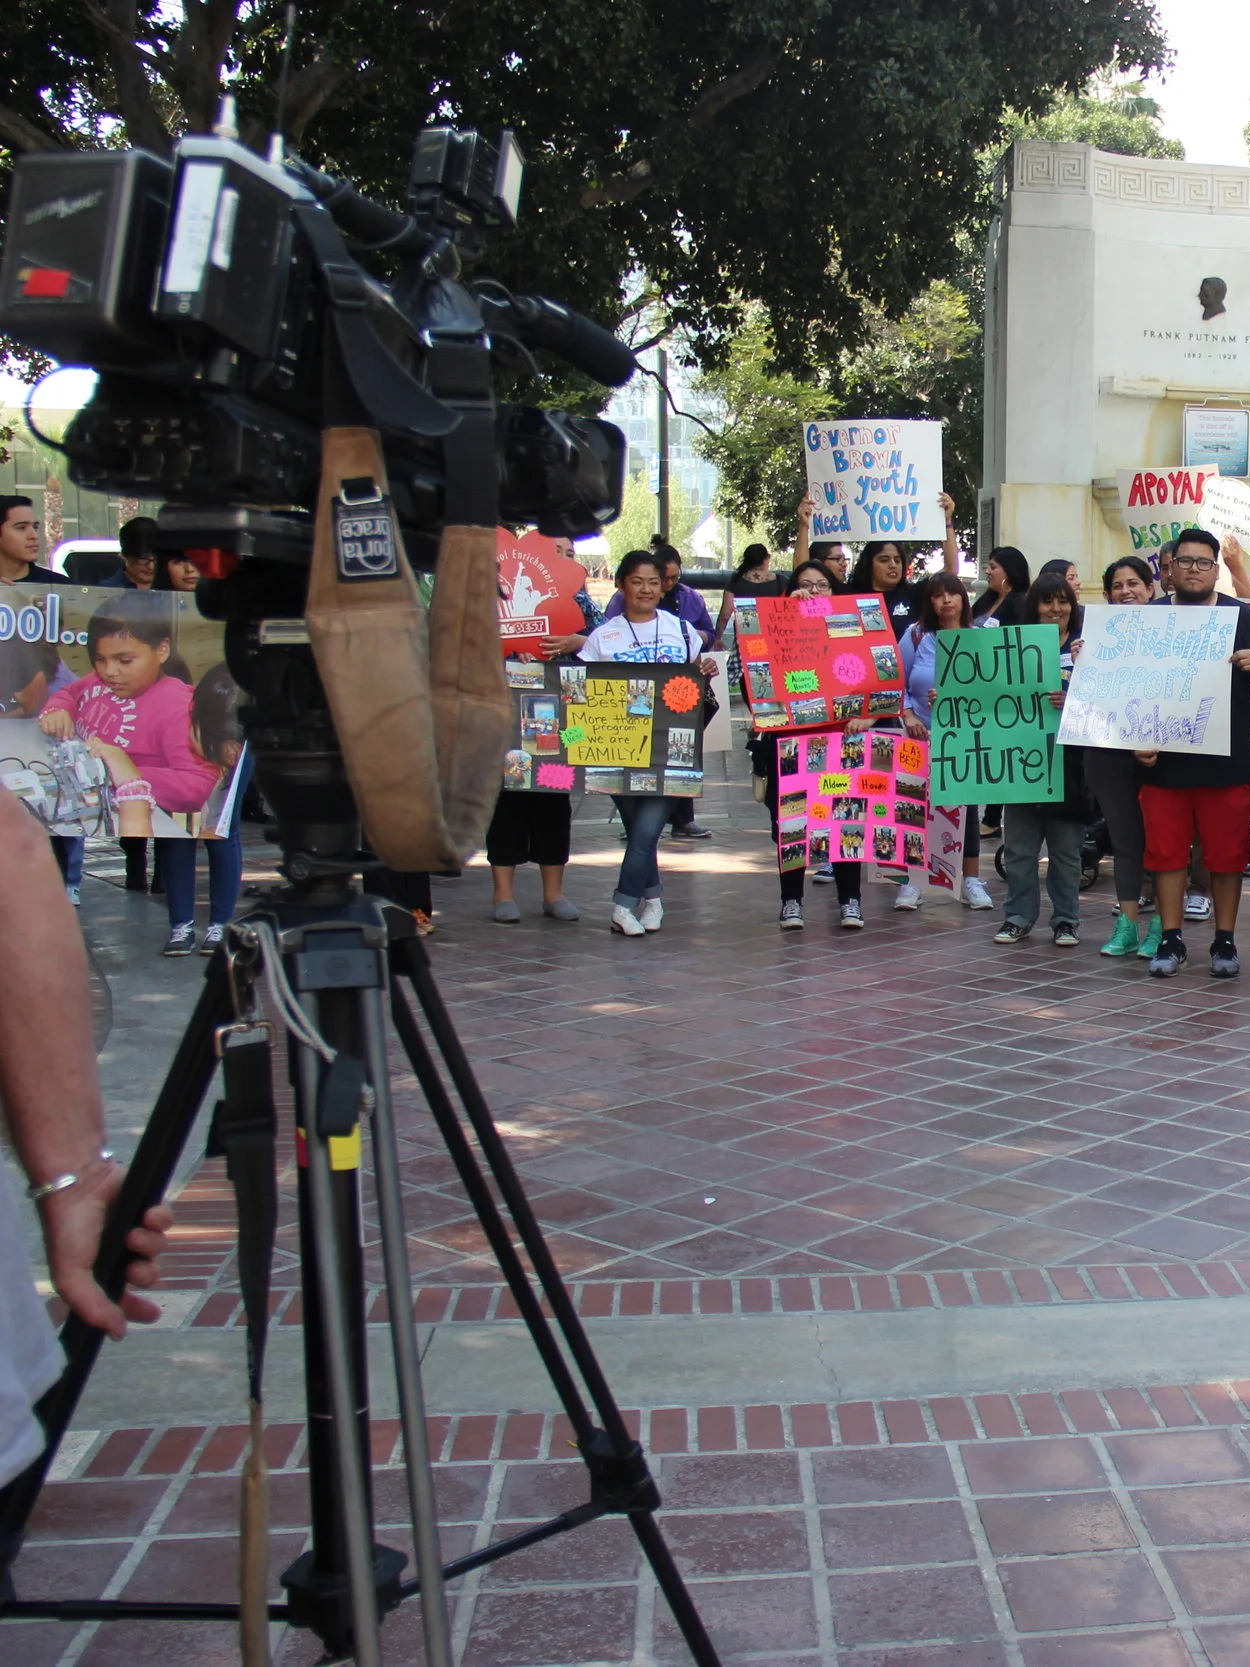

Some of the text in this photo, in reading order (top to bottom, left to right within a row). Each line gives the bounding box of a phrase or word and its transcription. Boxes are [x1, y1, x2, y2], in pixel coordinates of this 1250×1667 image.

[1143, 330, 1181, 340] FRANK
[1189, 333, 1236, 343] PUTNAM
[807, 424, 900, 451] Governor
[833, 449, 902, 472] BROWN
[810, 464, 918, 510] OUR youth
[812, 502, 920, 536] Need YOU!
[512, 549, 555, 584] Enrichment
[515, 620, 544, 634] BEST
[1093, 610, 1233, 661] Students
[938, 627, 1043, 692] Youth
[587, 695, 627, 708] Best
[592, 680, 627, 697] LA's
[571, 712, 607, 725] More
[614, 713, 638, 725] than
[936, 691, 1052, 730] are our
[1119, 696, 1216, 746] School
[587, 736, 630, 744] we are
[592, 724, 637, 734] program
[578, 735, 648, 762] FAMILY!
[899, 753, 920, 768] BEST
[931, 732, 1056, 795] future!
